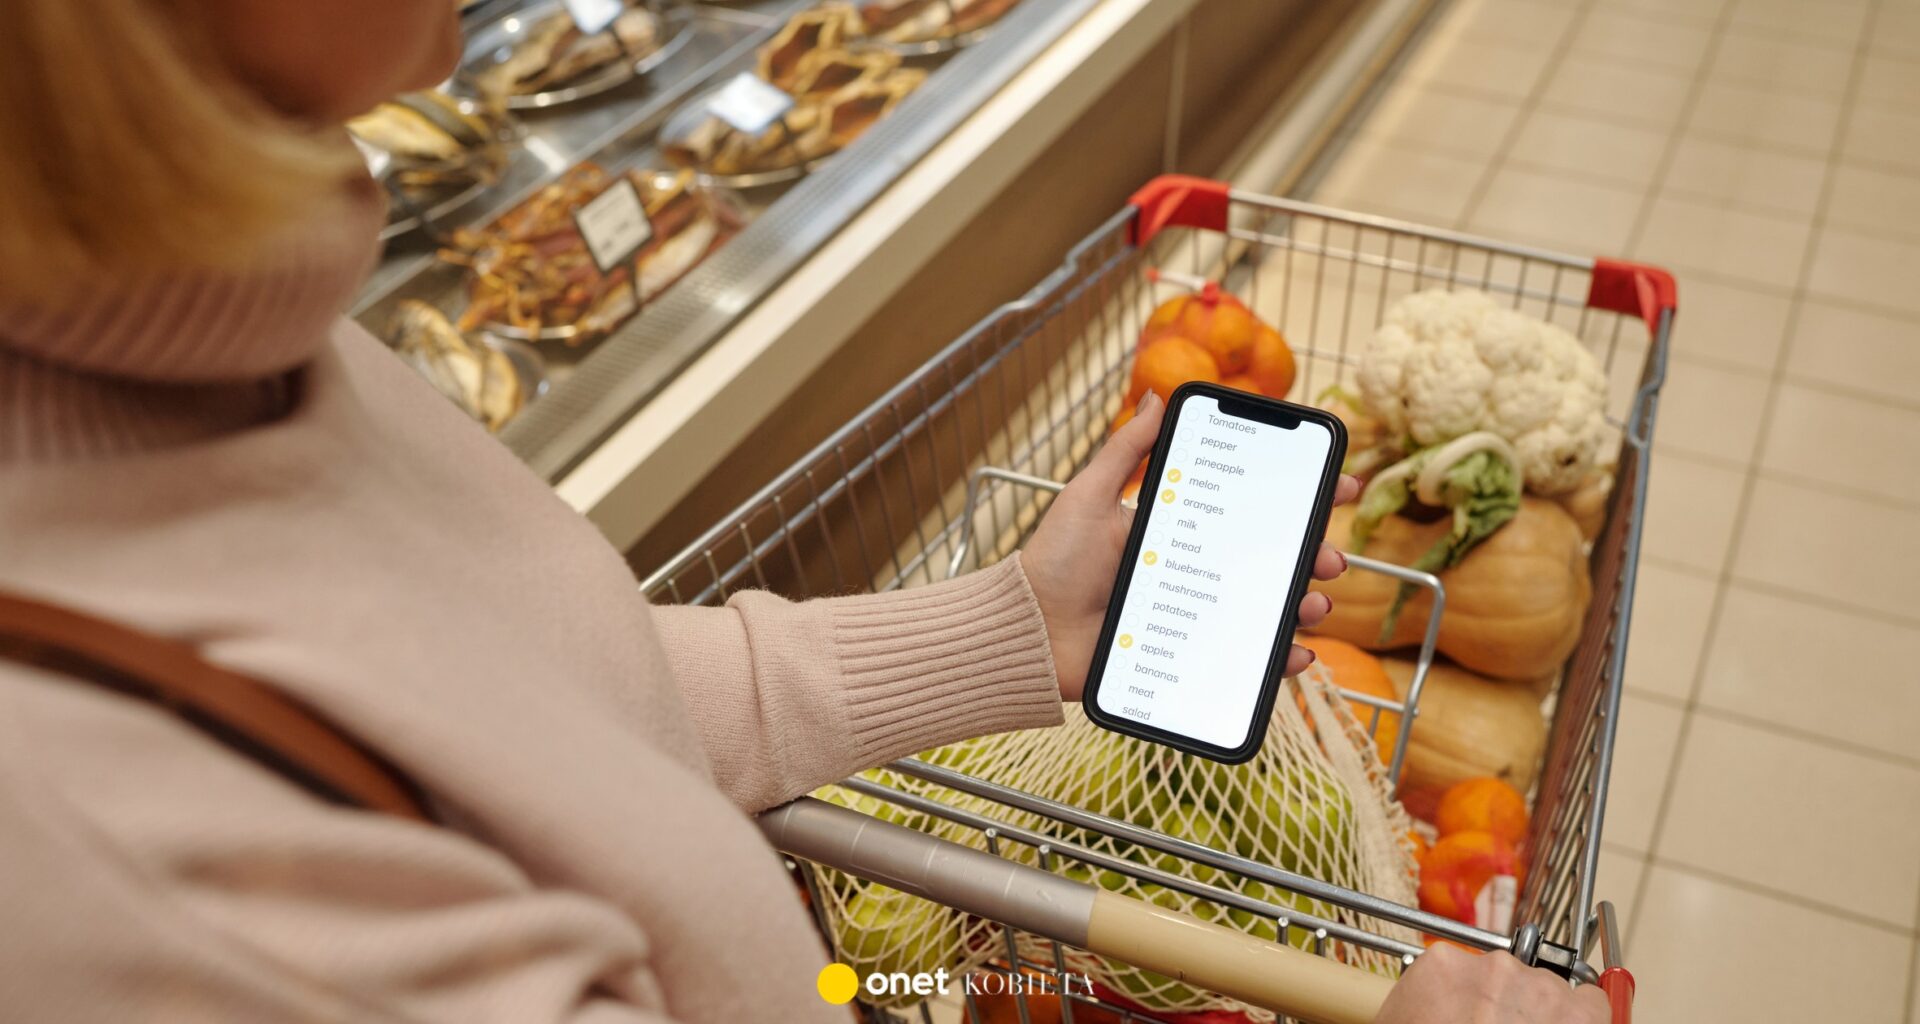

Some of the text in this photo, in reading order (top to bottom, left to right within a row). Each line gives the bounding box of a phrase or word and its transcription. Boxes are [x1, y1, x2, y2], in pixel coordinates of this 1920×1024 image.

[1208, 414, 1257, 435] Tomatoes
[1200, 435, 1238, 452] pepper
[1194, 455, 1245, 476] pineapple
[1189, 476, 1220, 492] melon
[1183, 497, 1224, 516] oranges
[1177, 517, 1198, 531] milk
[1171, 538, 1201, 554] bread
[1165, 558, 1222, 582] blueberries
[1158, 580, 1218, 603] mushrooms
[1152, 601, 1198, 620] potatoes
[1146, 622, 1189, 640] peppers
[1140, 643, 1175, 659] apples
[1134, 662, 1180, 683] bananas
[1128, 684, 1155, 700] meat
[1122, 705, 1152, 721] salad
